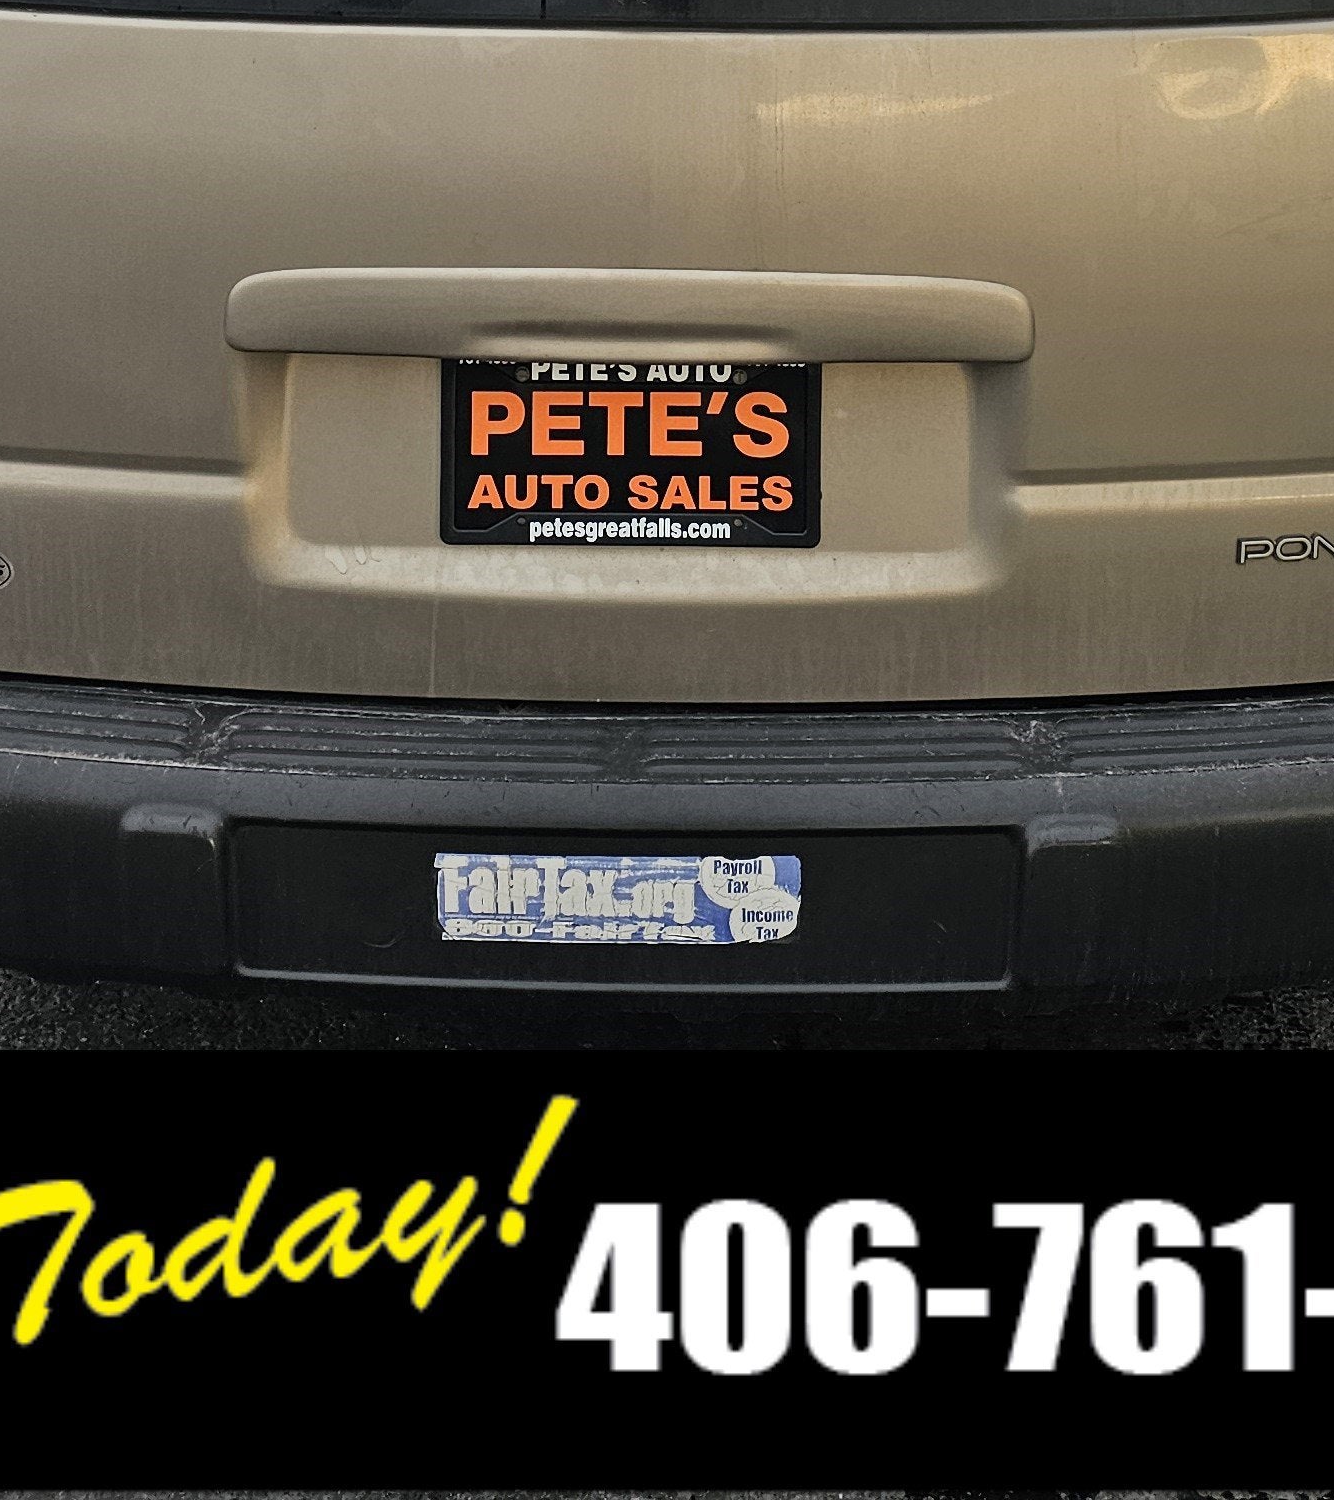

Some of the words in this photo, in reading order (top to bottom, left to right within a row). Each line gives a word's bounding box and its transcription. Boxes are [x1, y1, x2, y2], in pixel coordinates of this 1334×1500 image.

[531, 362, 638, 382] PETE'S
[646, 364, 732, 383] AUTO
[470, 390, 790, 458] PETE'S
[467, 474, 611, 510] AUTO
[627, 475, 794, 511] SALES
[529, 517, 732, 543] petesgreatfalls.com
[713, 859, 763, 876] Payroll
[726, 878, 749, 894] Tax
[741, 907, 794, 923] Income
[756, 926, 779, 941] Tax
